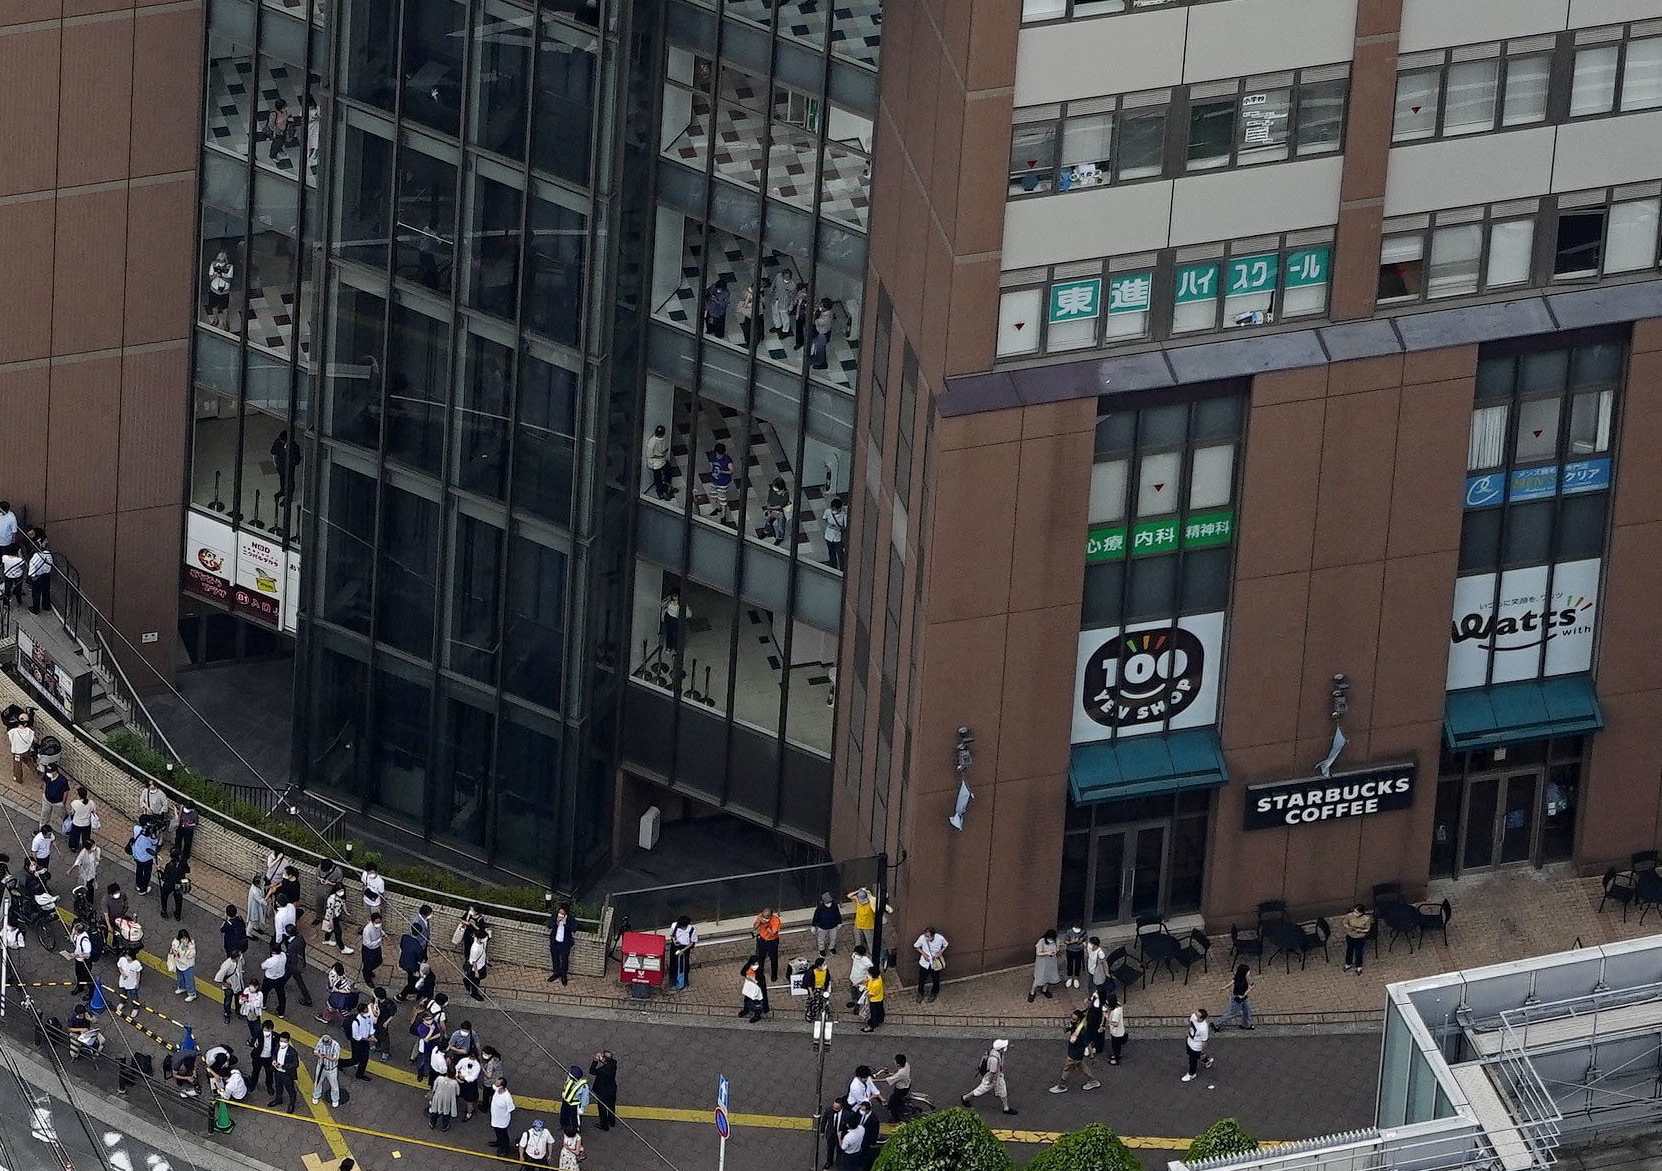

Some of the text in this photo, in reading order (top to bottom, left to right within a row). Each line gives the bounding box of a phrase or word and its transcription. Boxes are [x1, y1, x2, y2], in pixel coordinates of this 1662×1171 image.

[1086, 526, 1175, 554] 心療内科
[1451, 608, 1576, 644] Watts
[1562, 626, 1591, 637] with
[1102, 649, 1188, 688] 100
[1136, 678, 1192, 720] SHOP
[1257, 778, 1410, 812] STARBUCKS
[1285, 798, 1379, 825] COFFEE
